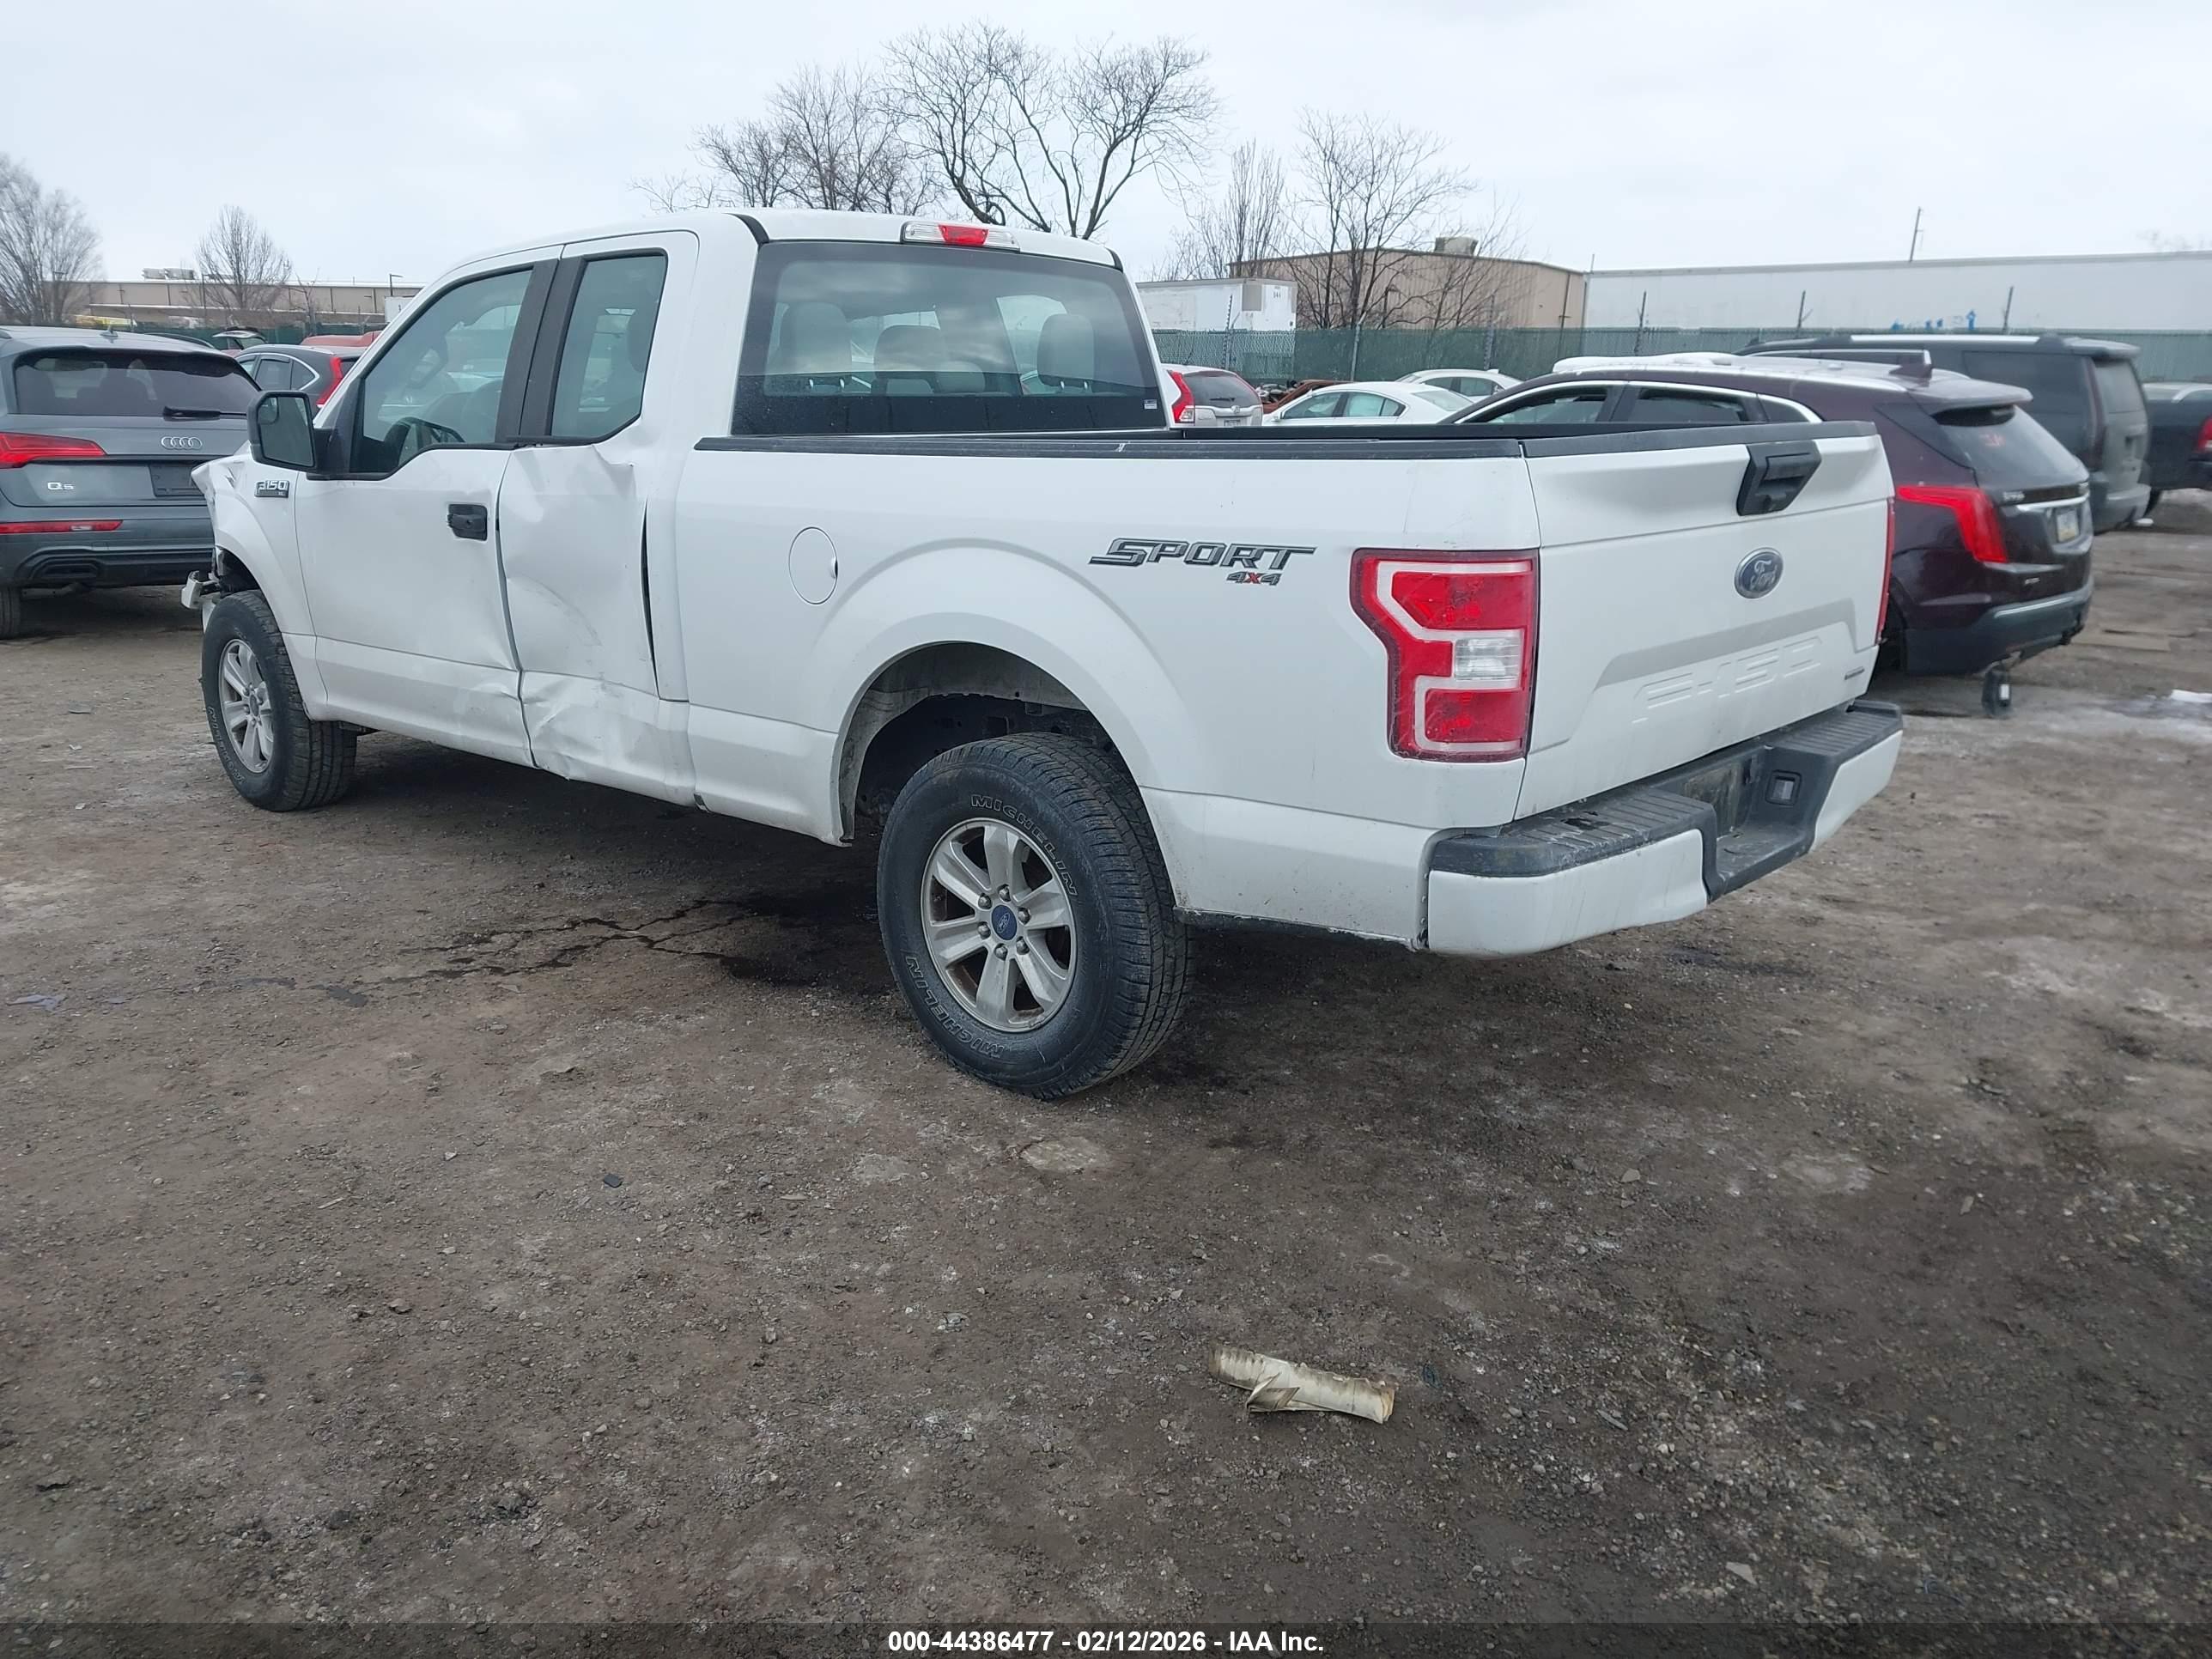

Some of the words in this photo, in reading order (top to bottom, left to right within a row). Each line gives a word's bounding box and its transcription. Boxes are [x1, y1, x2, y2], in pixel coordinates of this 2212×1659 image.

[47, 482, 75, 490] Q5
[1088, 538, 1318, 570] SPORT
[970, 793, 1079, 896] MICHELIN
[905, 956, 1005, 1059] MICHELIN
